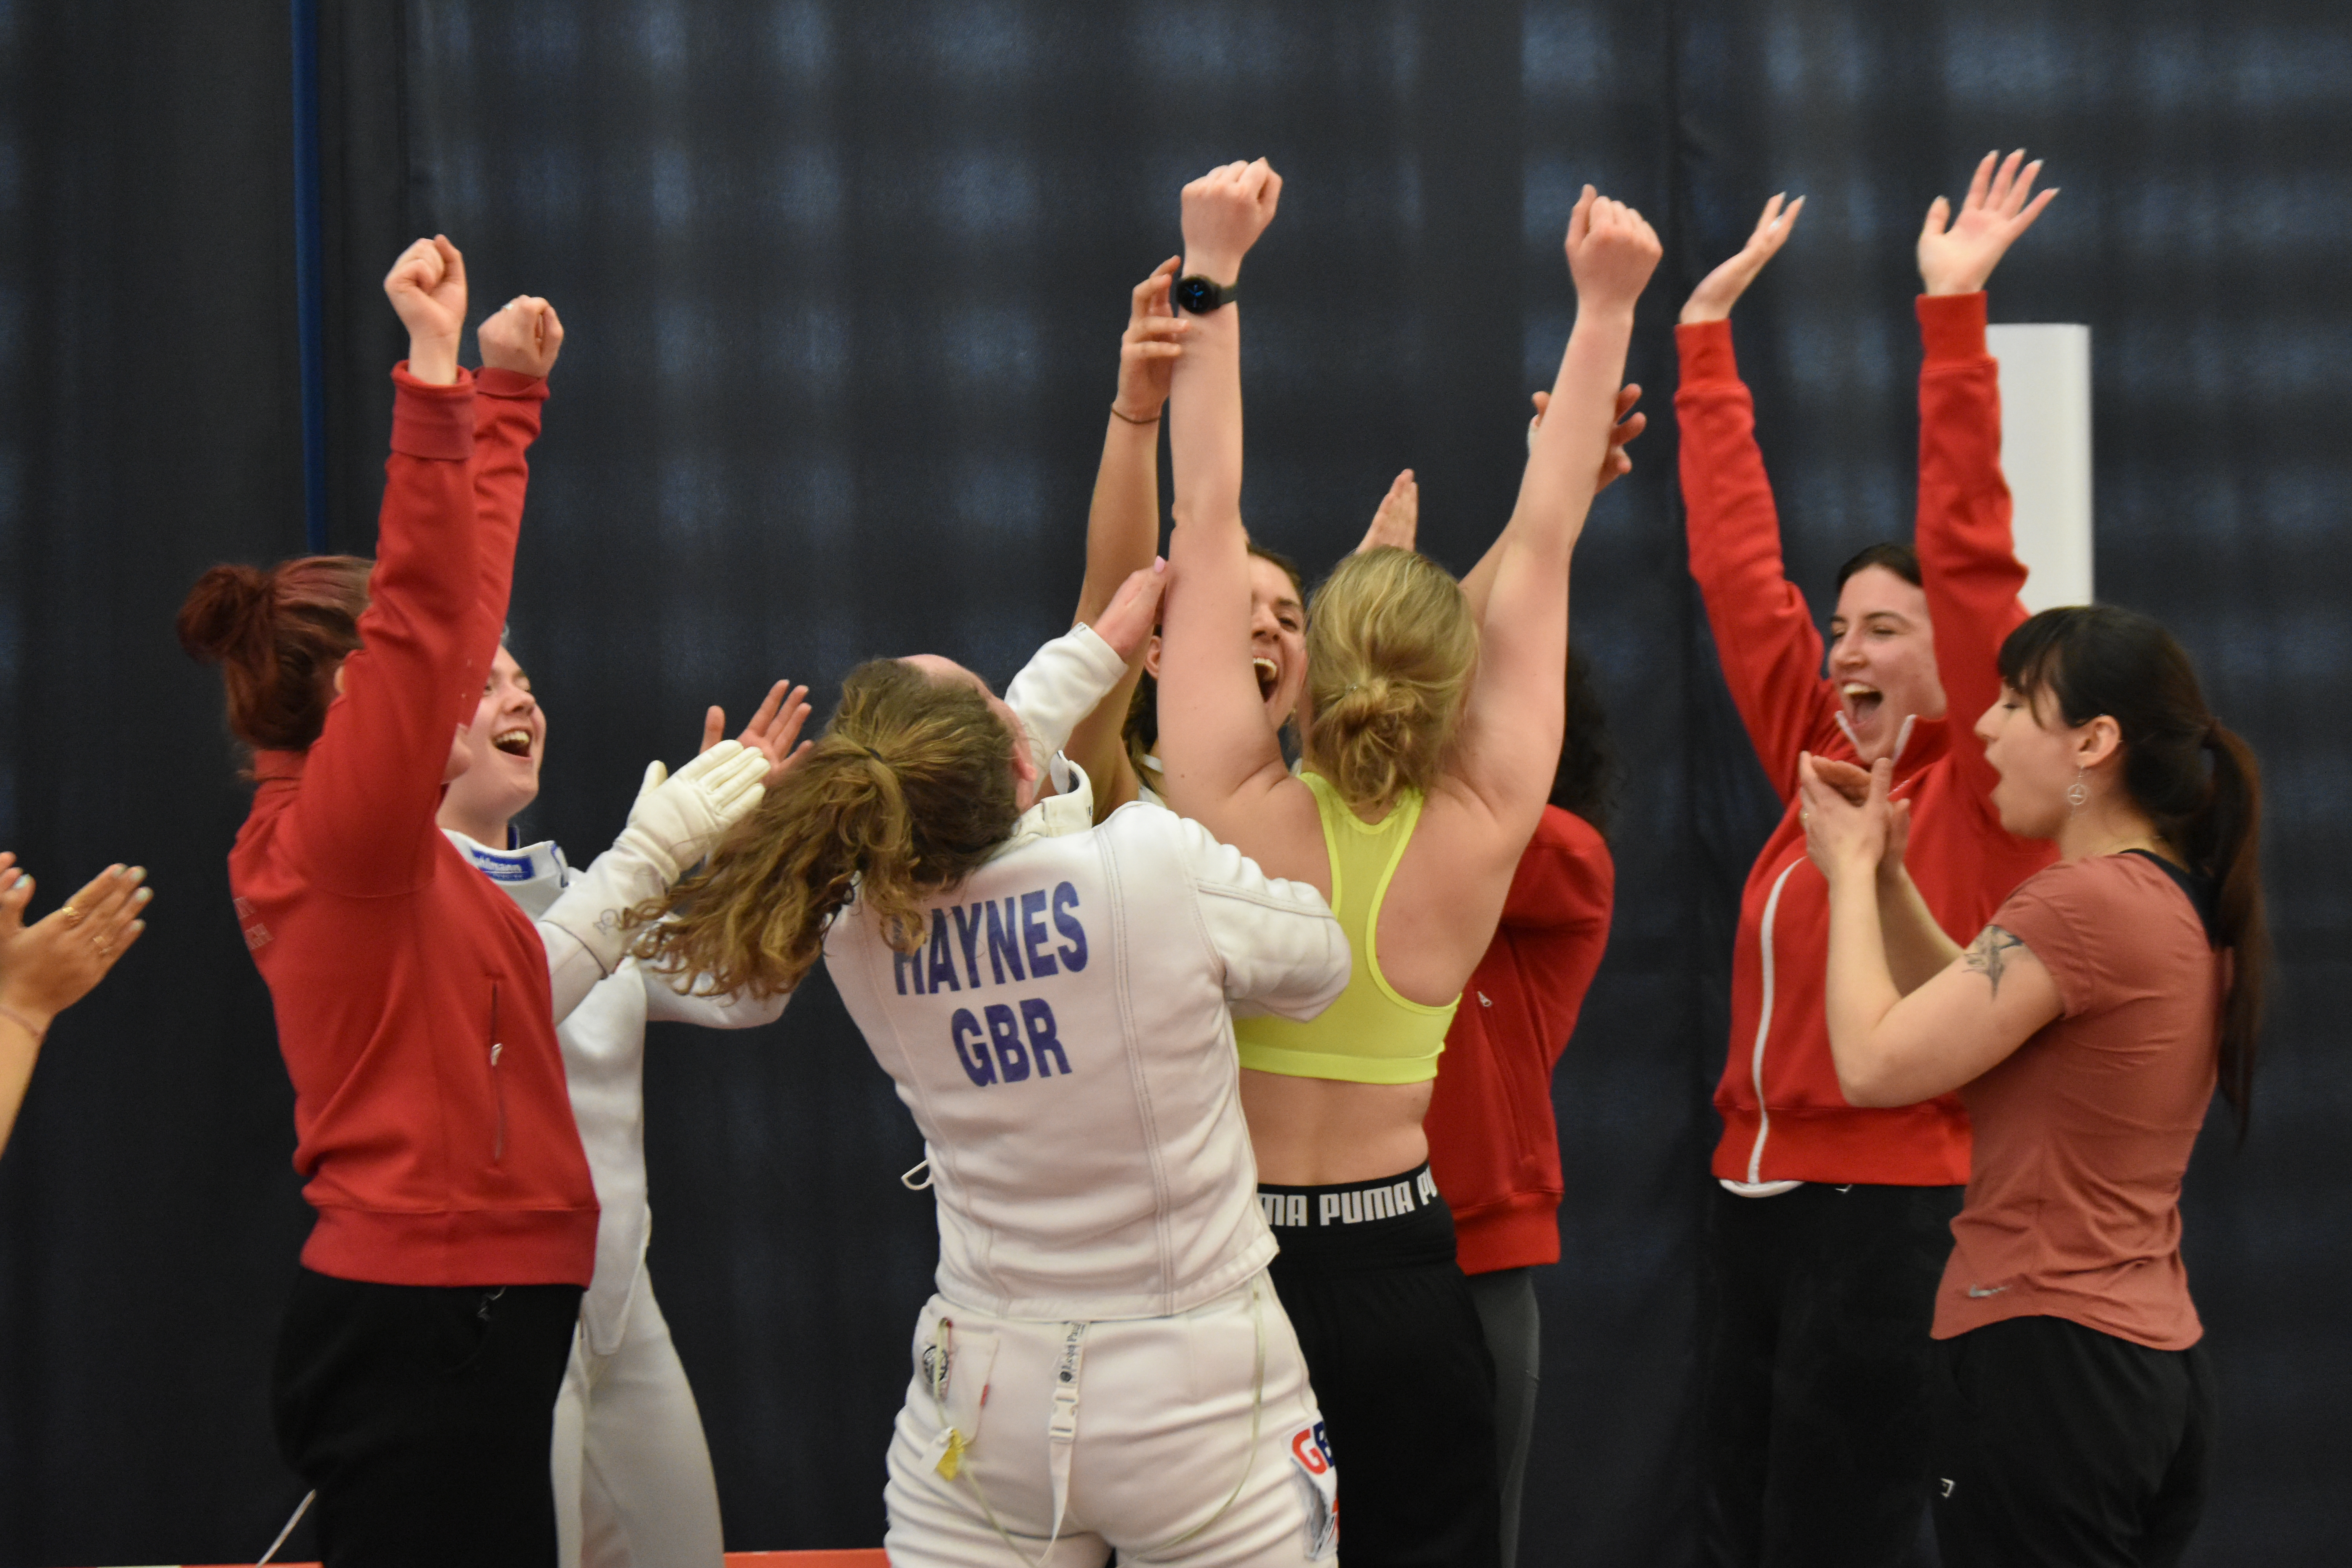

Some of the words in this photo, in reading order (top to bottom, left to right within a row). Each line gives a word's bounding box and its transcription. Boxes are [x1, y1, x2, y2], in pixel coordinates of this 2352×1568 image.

[891, 881, 1088, 995] HAYNES
[951, 998, 1072, 1087] GBR
[1319, 1180, 1416, 1226] PUMA
